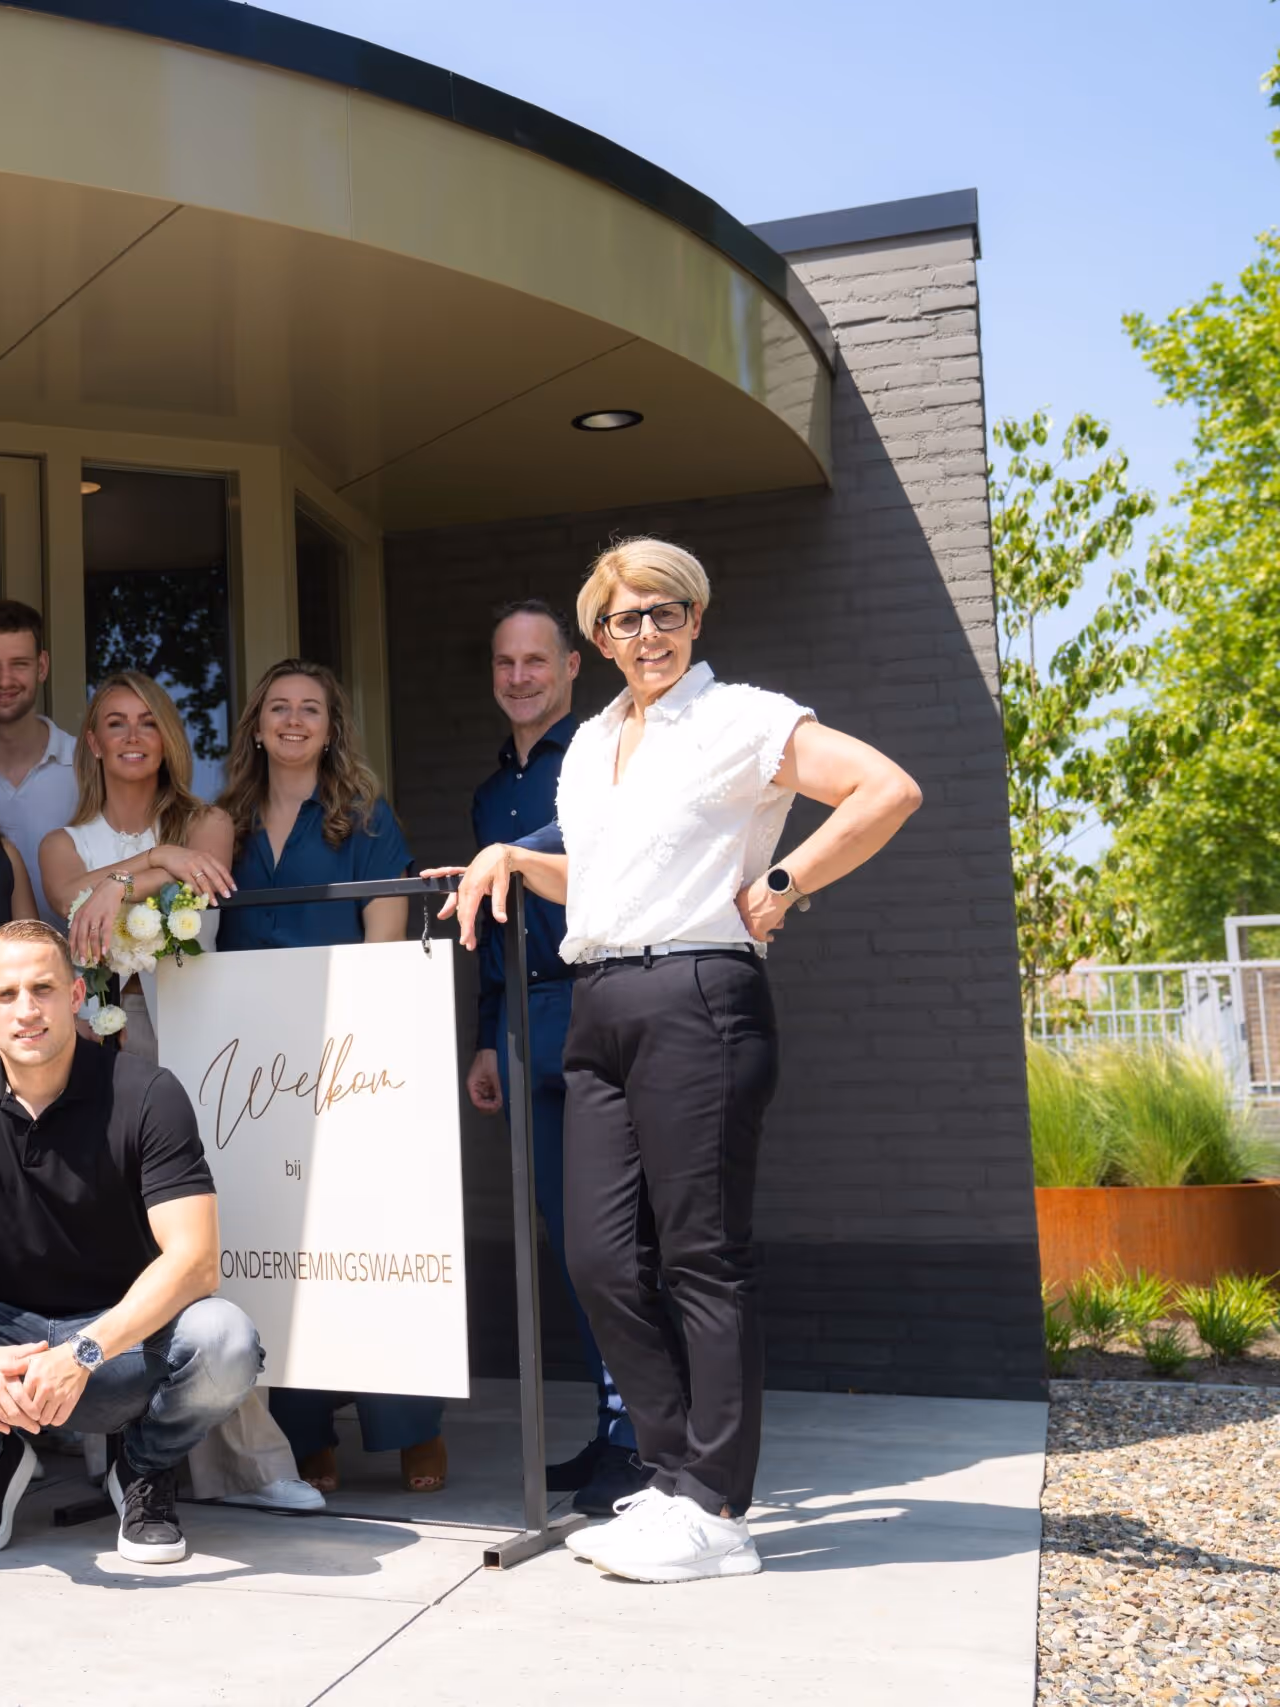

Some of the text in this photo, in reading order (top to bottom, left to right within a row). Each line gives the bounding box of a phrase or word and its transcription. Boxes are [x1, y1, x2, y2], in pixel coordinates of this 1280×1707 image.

[199, 1034, 406, 1149] Welkom
[285, 1159, 301, 1180] bij
[220, 1249, 452, 1283] ONDERNEMINGSWAARDE
